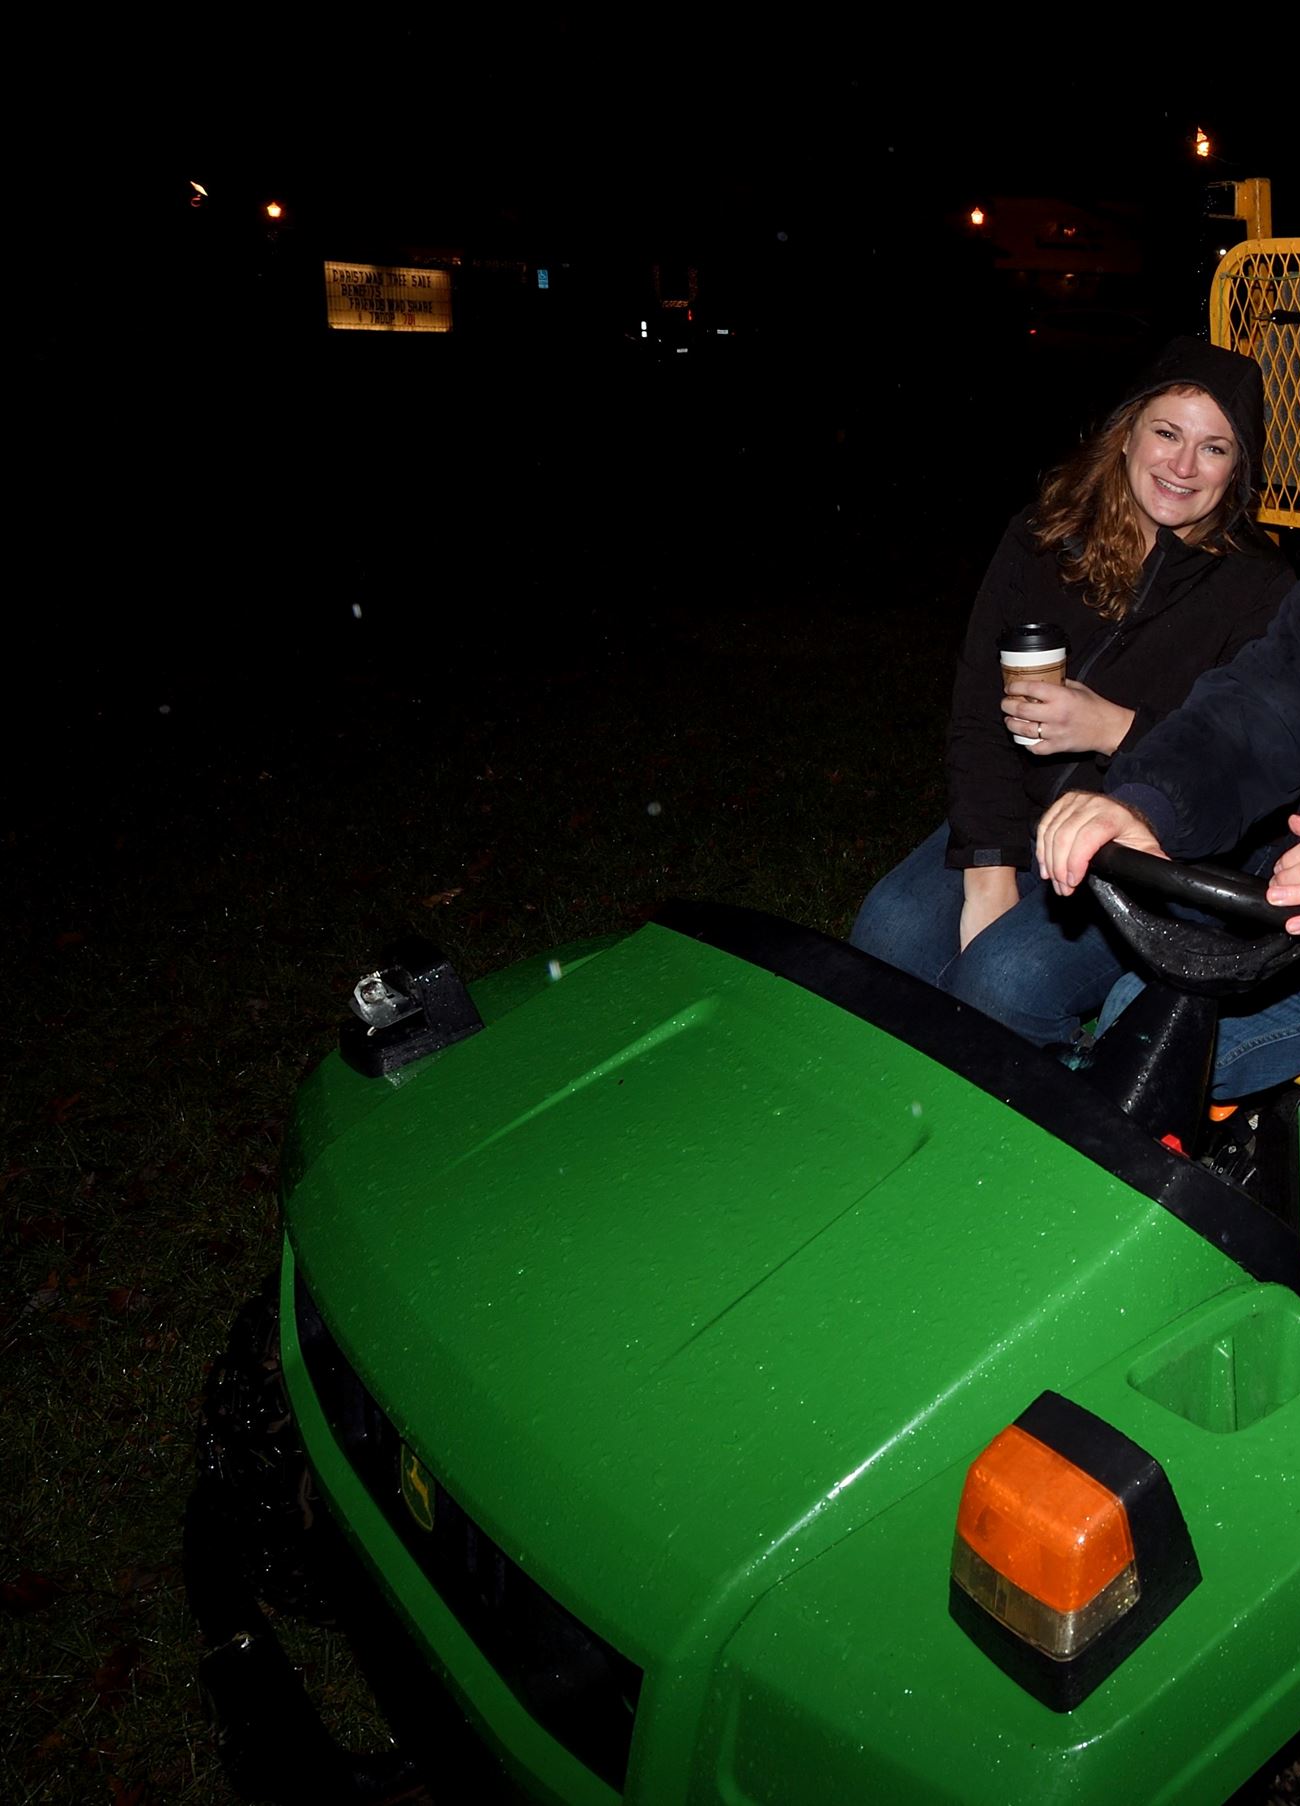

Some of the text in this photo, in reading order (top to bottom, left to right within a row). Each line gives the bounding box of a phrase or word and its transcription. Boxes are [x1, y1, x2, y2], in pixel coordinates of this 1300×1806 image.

[333, 269, 432, 288] CHRISTMAS TREE SALE
[341, 283, 382, 298] BENEFITS
[349, 297, 433, 313] FRIENDS WHO SHARE
[370, 312, 396, 325] TROOP
